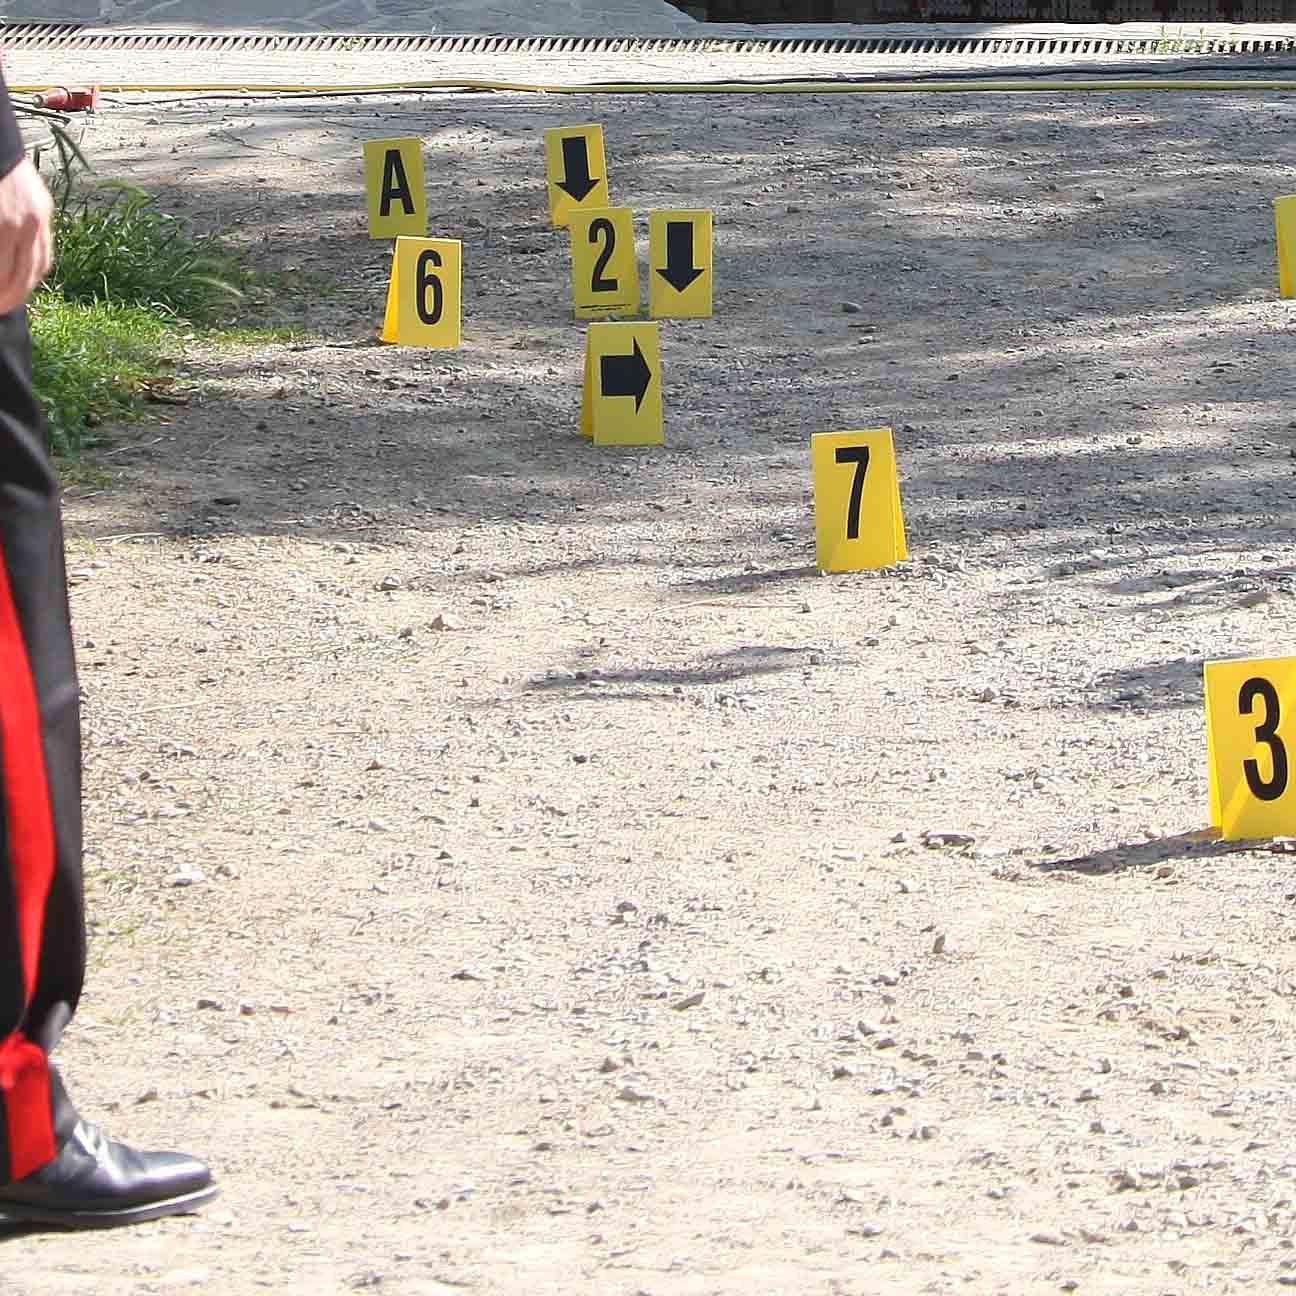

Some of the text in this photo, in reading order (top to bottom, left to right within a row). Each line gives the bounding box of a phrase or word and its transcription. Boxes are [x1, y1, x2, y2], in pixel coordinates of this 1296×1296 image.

[379, 149, 415, 217] A
[415, 249, 444, 325] 6
[589, 217, 618, 292] 2
[835, 446, 870, 539] 7
[1238, 677, 1288, 801] 3
